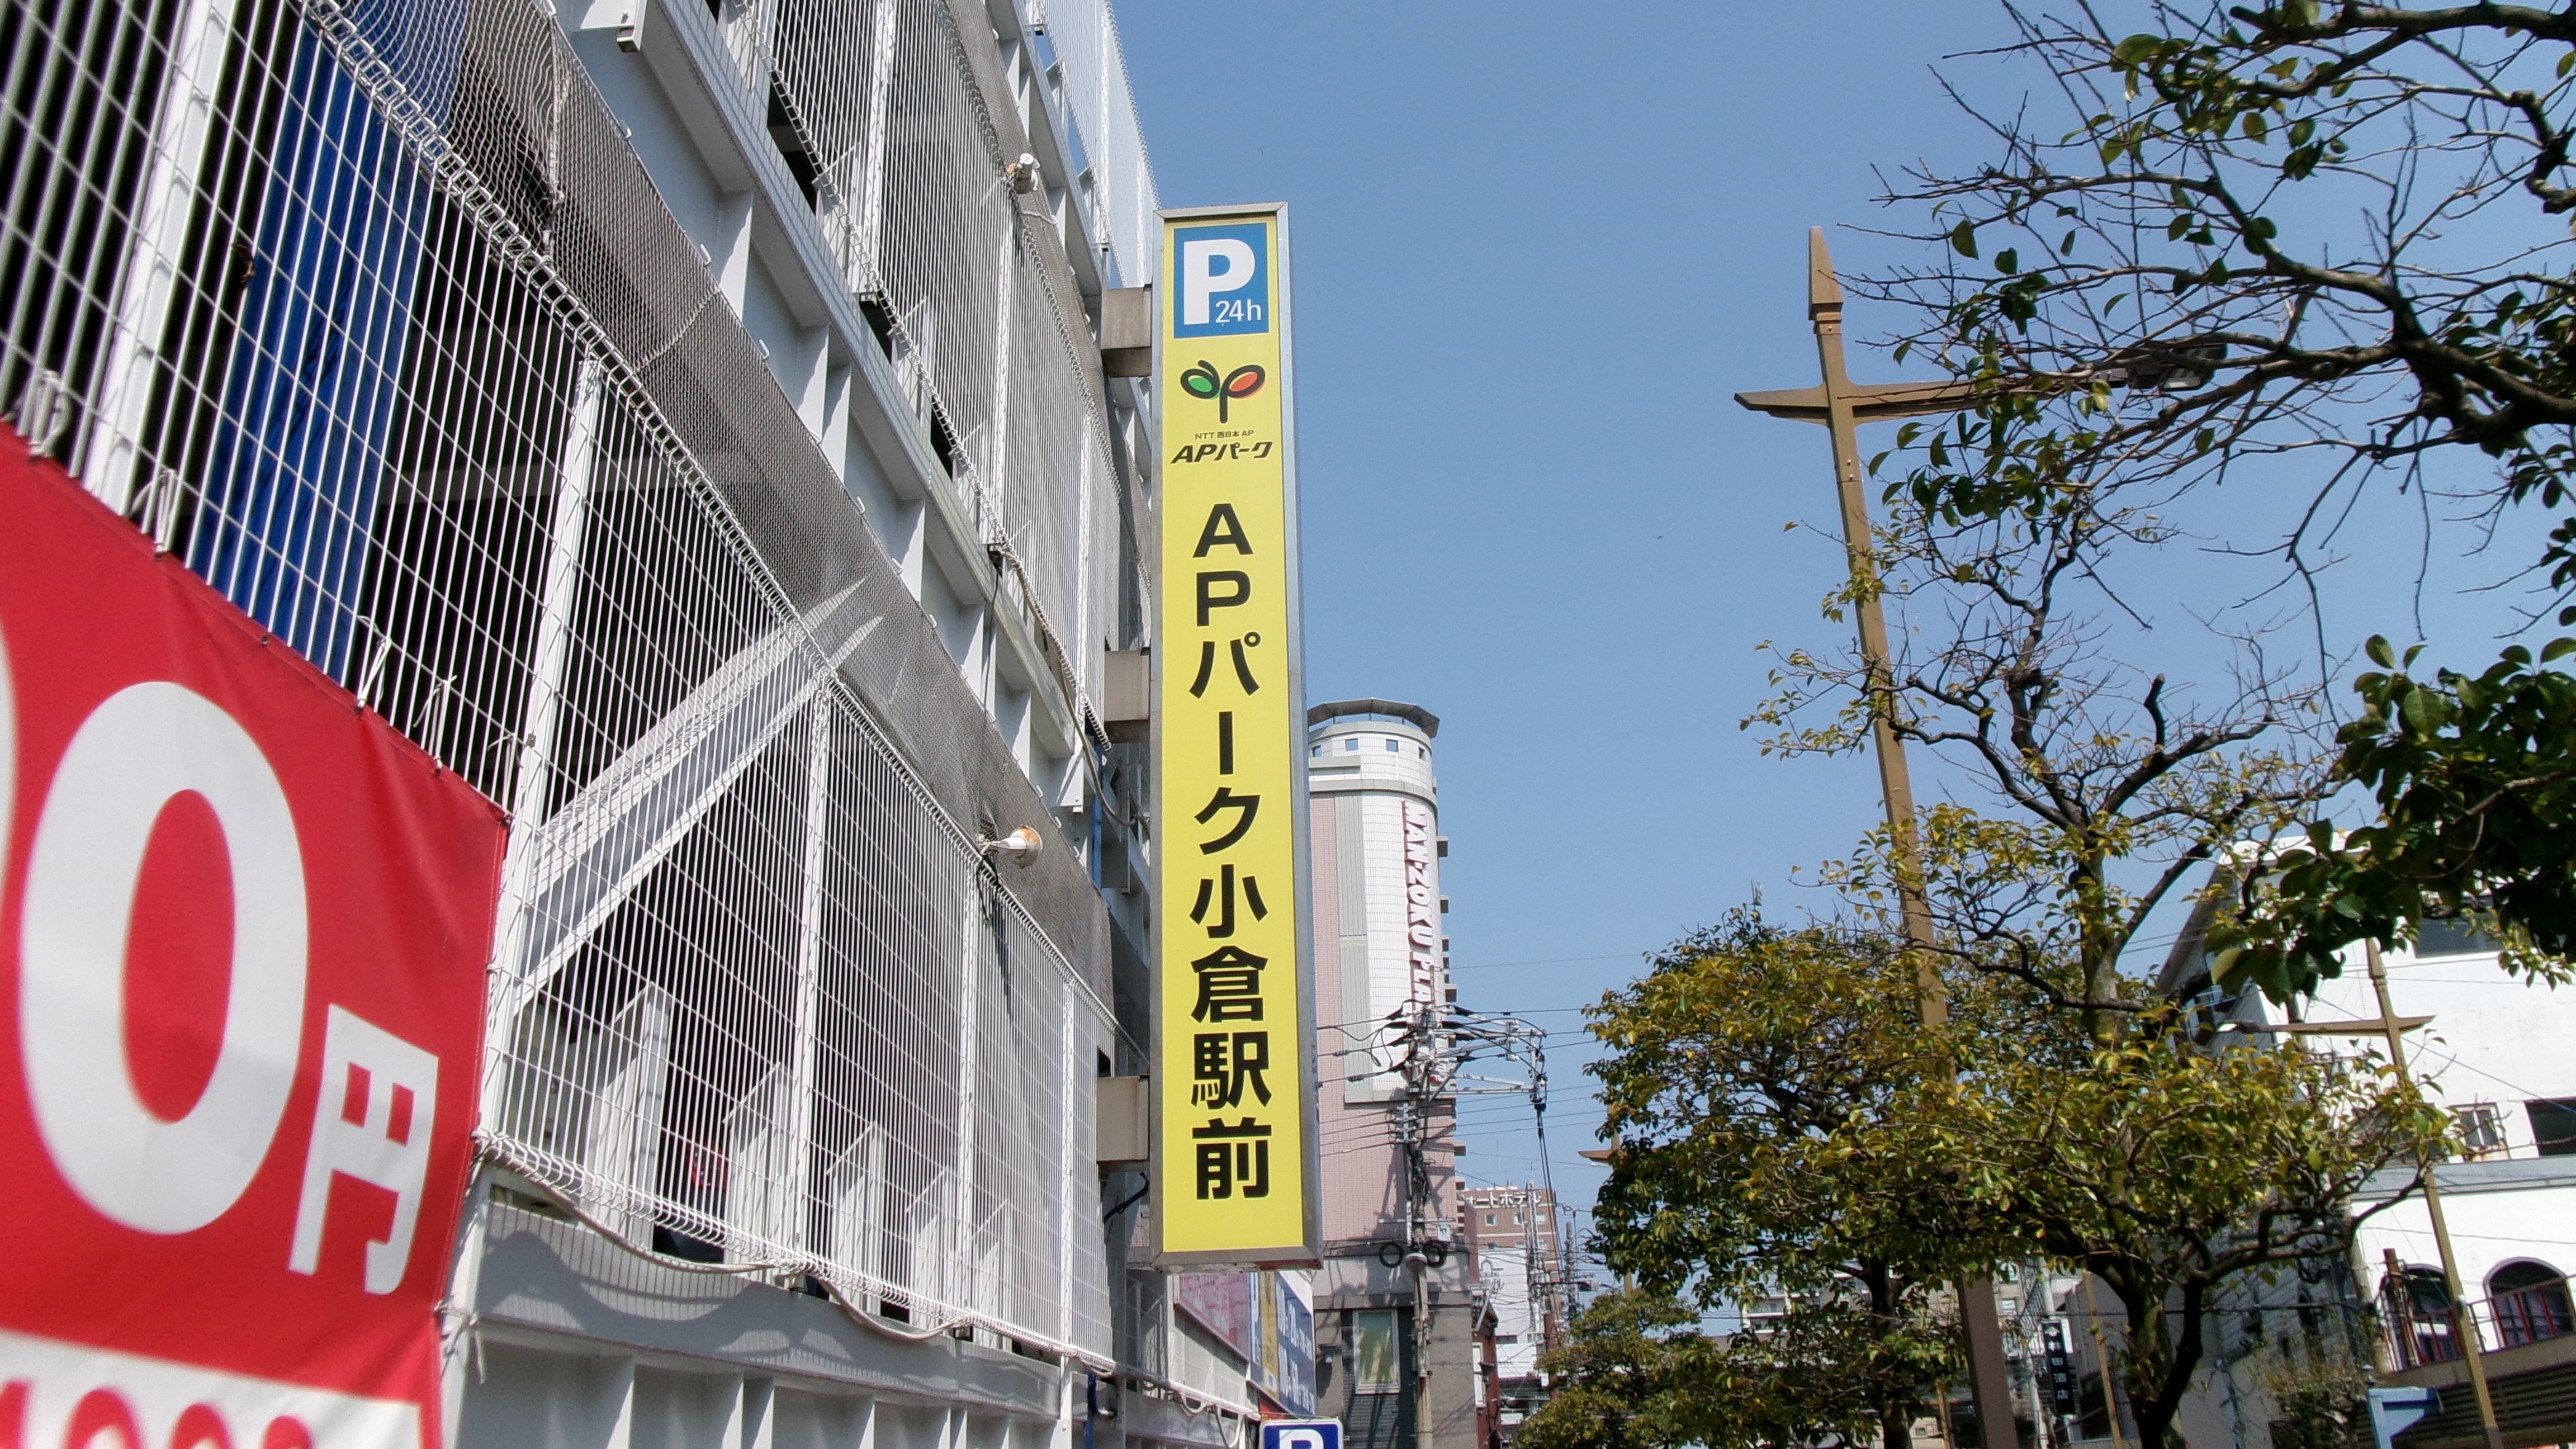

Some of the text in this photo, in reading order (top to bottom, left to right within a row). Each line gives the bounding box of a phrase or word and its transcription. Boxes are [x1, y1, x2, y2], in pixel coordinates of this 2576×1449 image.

[1184, 239, 1255, 325] P
[1215, 299, 1262, 324] 24h
[1217, 430, 1240, 438] 西日本
[1169, 441, 1273, 465] APパーク
[1188, 503, 1272, 1200] APパーク小倉駅前
